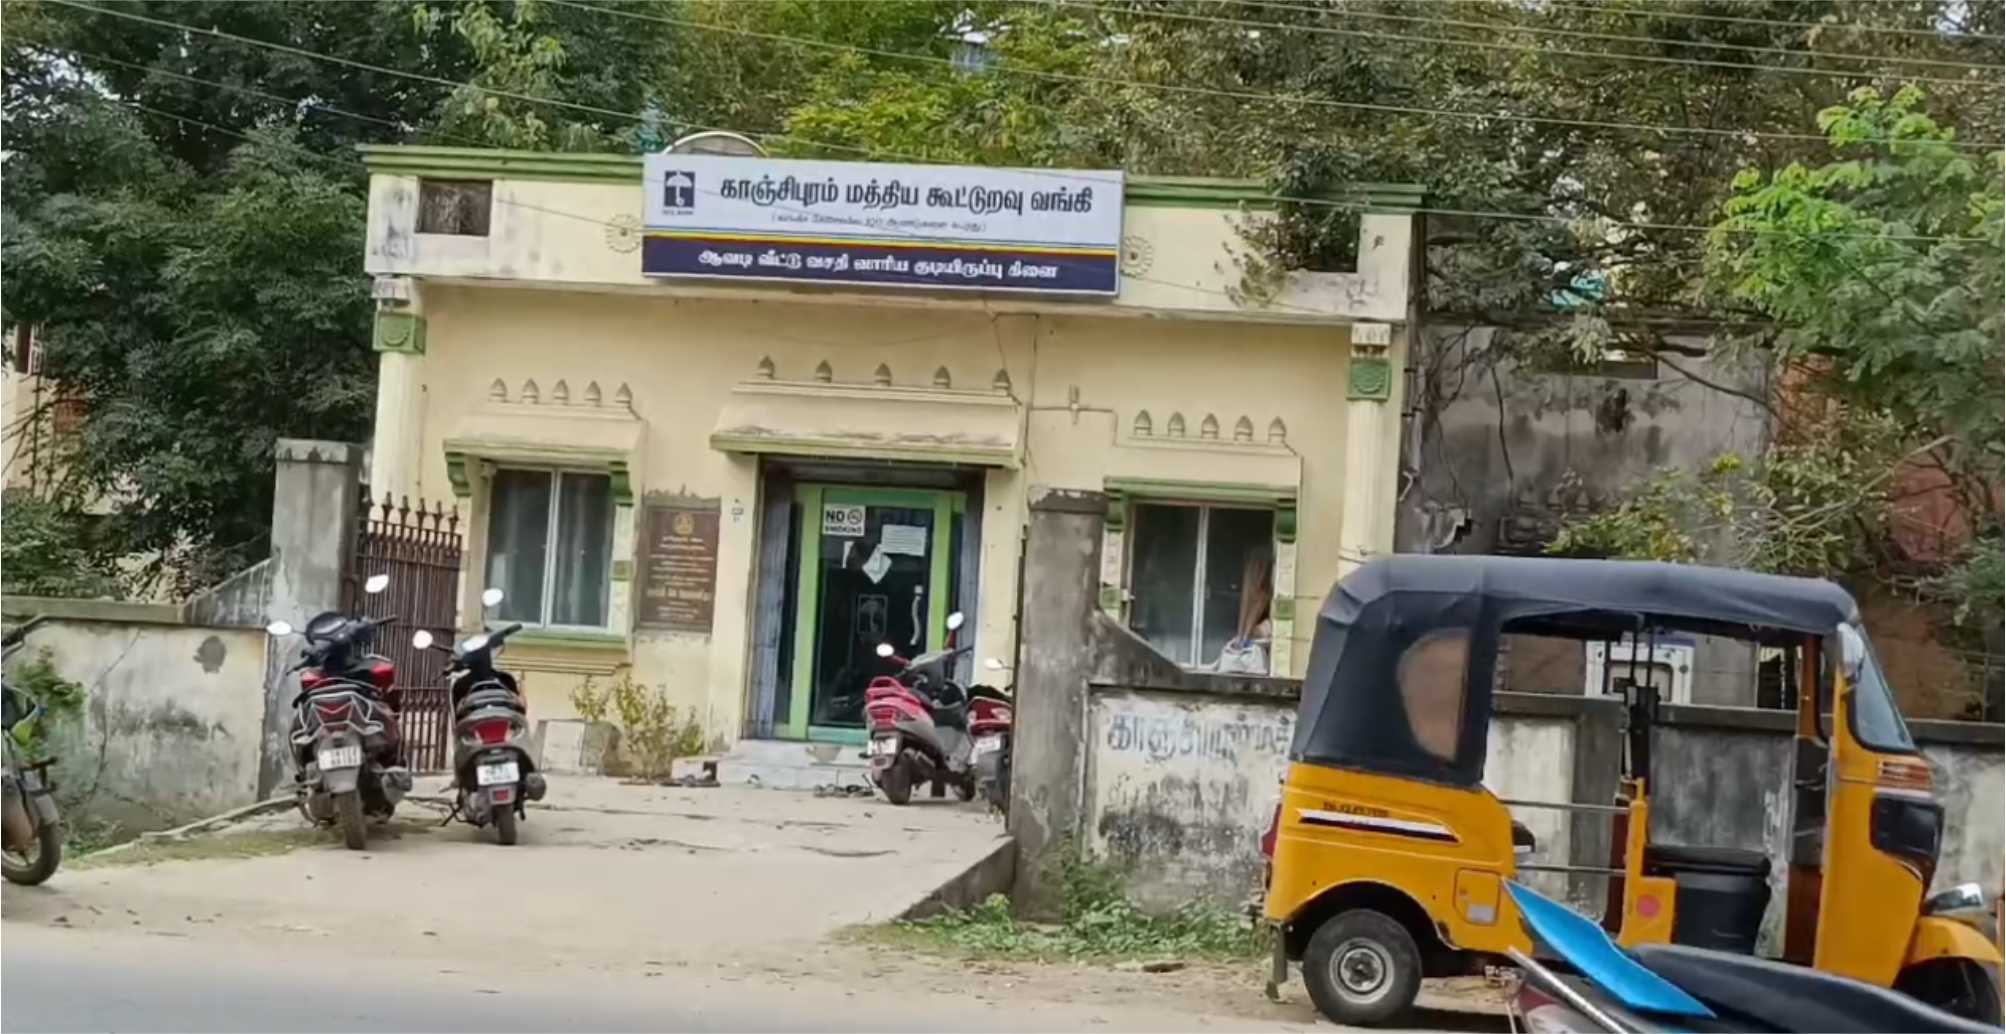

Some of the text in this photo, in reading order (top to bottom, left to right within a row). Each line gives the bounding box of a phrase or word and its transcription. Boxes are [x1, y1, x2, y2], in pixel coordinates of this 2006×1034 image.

[720, 174, 1093, 216] காஞ்சிபுரம் மத்திய கூட்டுறவு வங்கி
[698, 250, 753, 268] ஆவடி
[757, 249, 802, 270] வீட்டு
[806, 253, 849, 272] வசதி
[854, 254, 909, 271] வாரிய
[826, 510, 846, 522] NO
